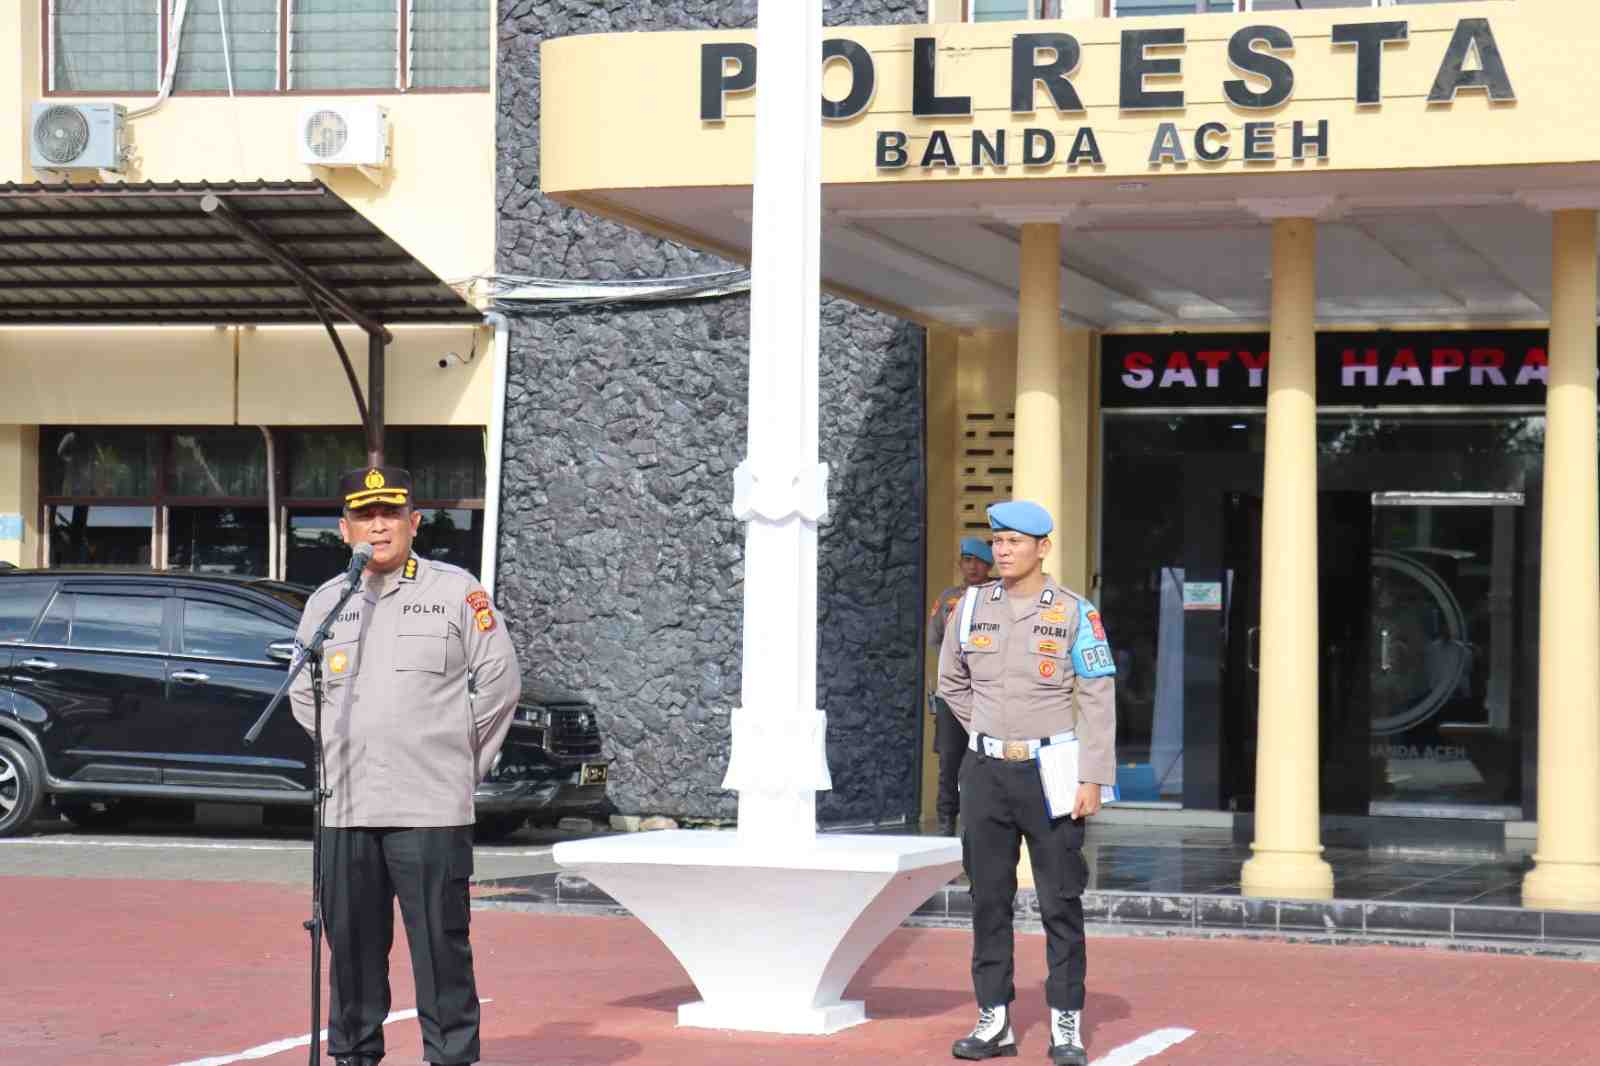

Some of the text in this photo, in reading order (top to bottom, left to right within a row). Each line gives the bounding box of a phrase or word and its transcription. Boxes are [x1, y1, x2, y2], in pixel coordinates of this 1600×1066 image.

[700, 18, 1516, 123] POLRESTA
[876, 119, 1329, 169] BANDA ACEH
[1121, 348, 1549, 388] SATY HAPRA
[336, 610, 360, 622] GUH
[403, 604, 445, 614] POLRI
[1033, 624, 1067, 638] POLRI
